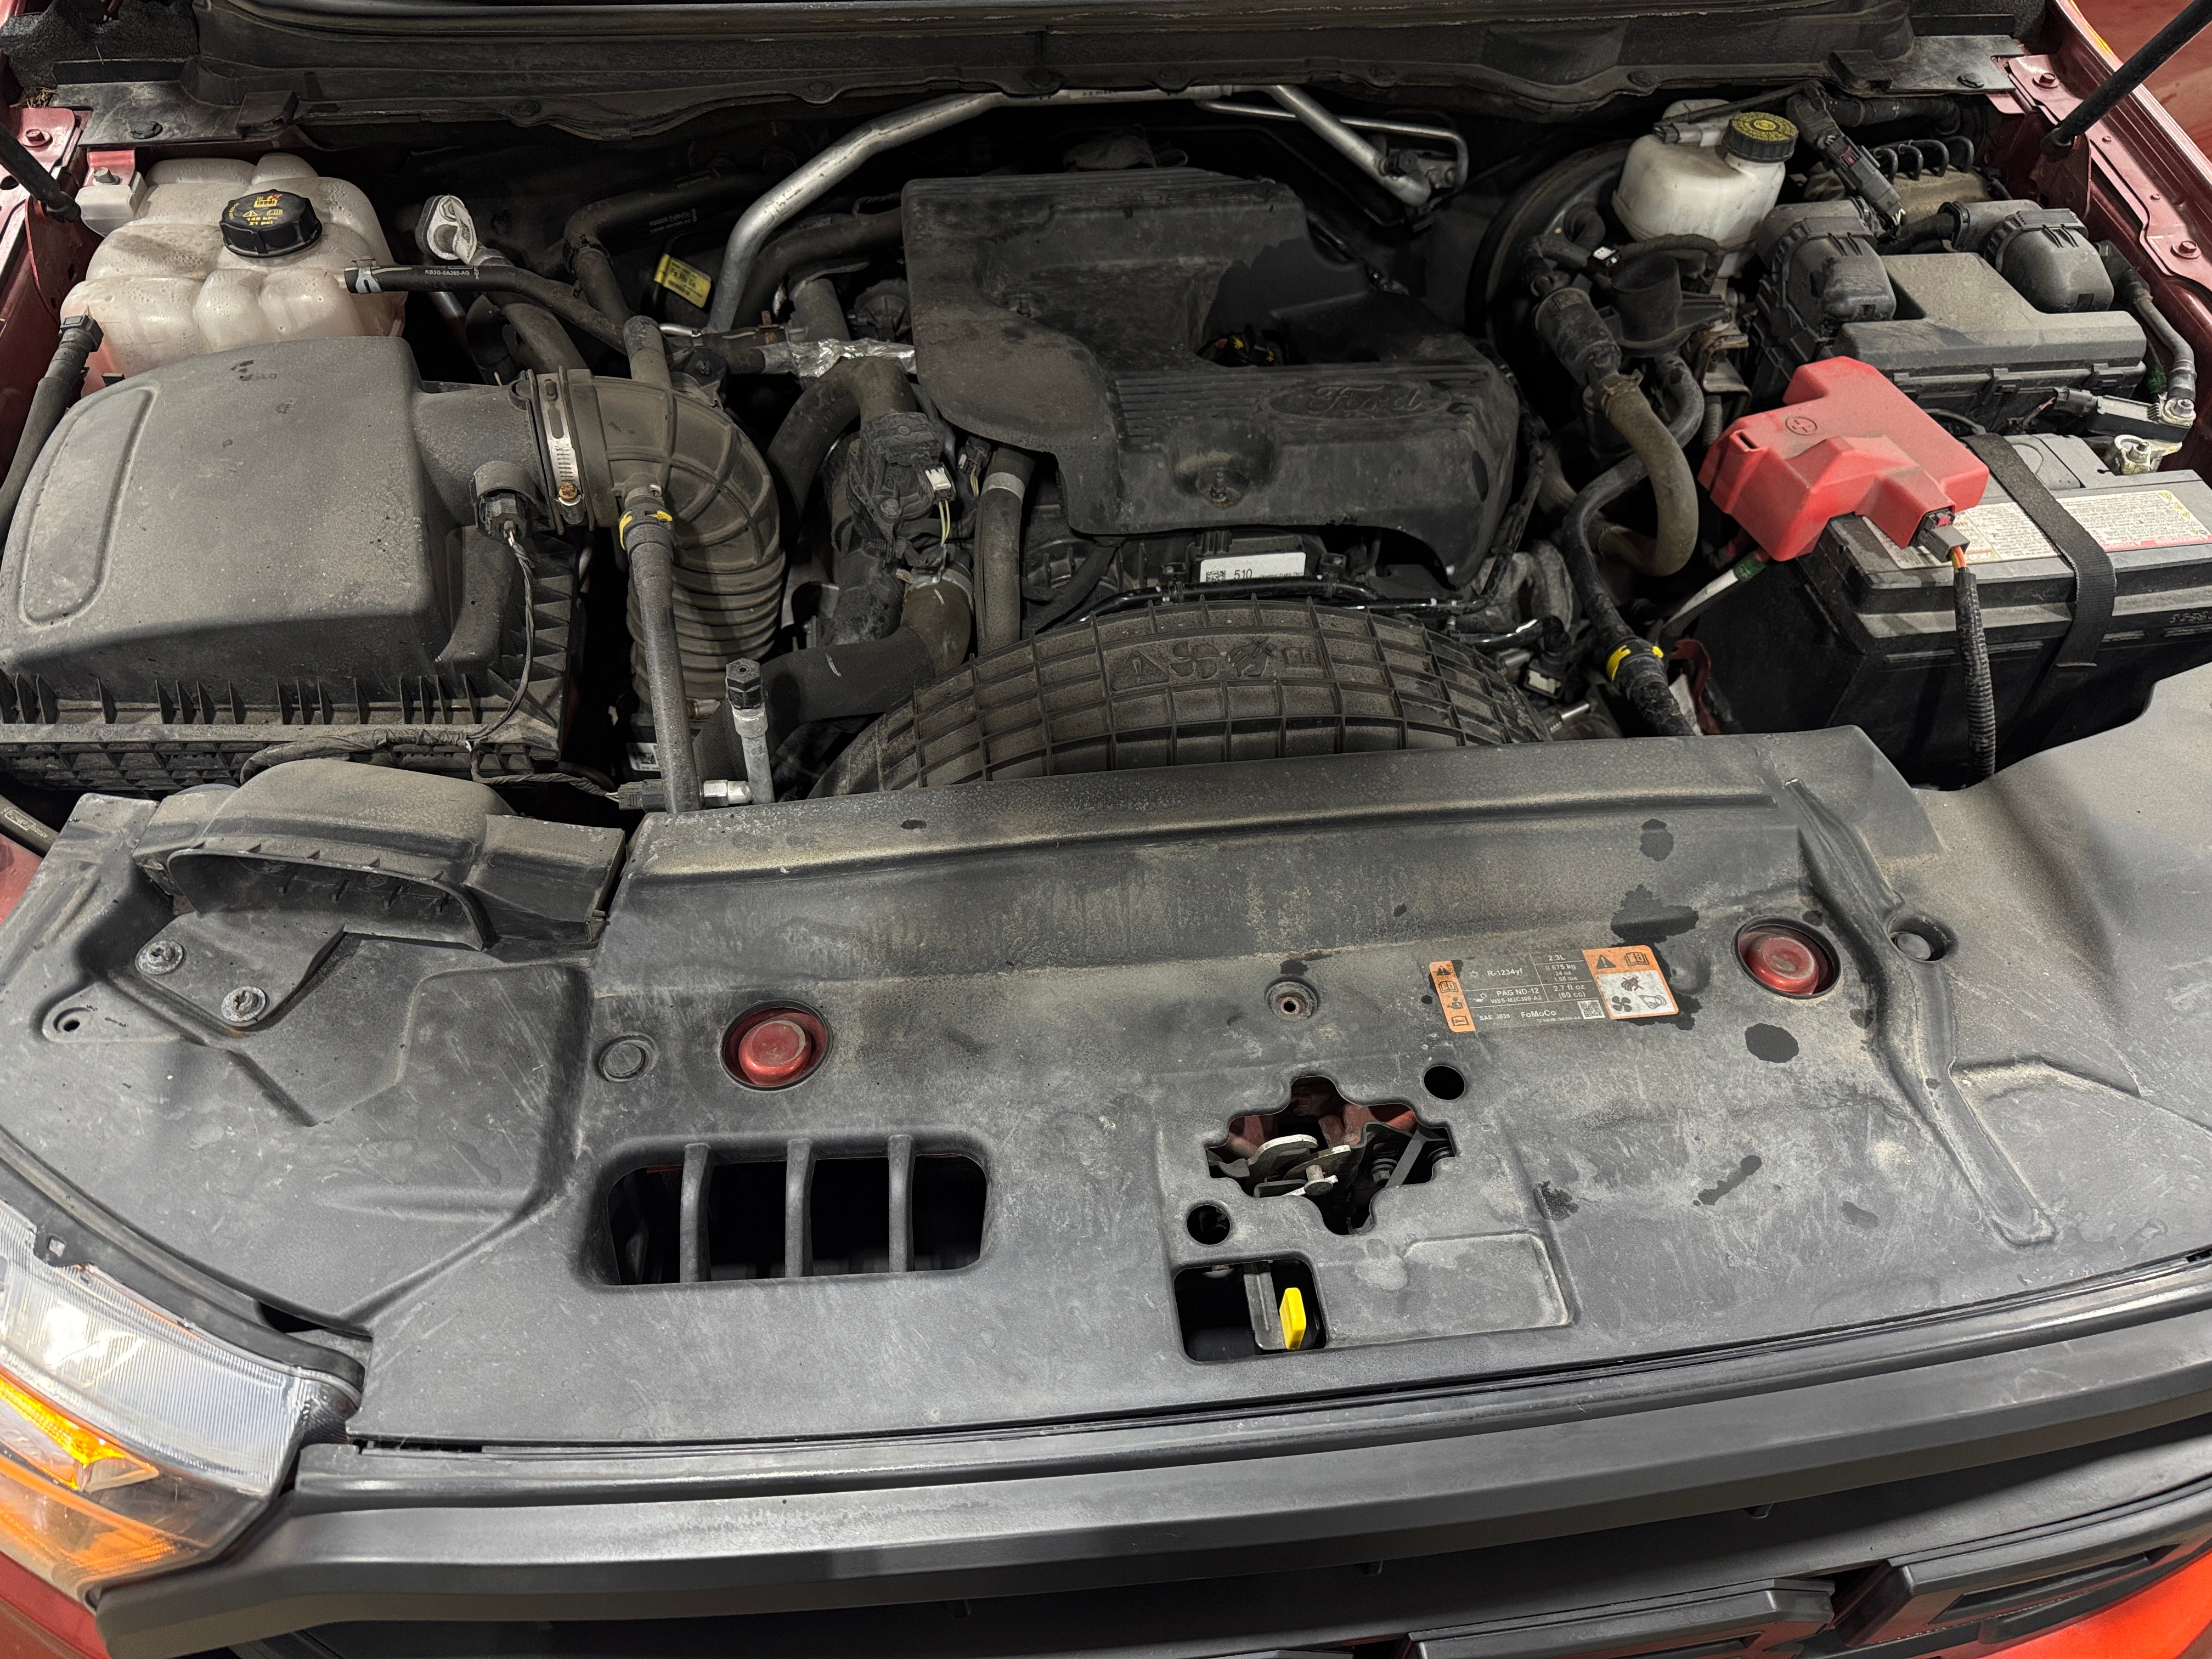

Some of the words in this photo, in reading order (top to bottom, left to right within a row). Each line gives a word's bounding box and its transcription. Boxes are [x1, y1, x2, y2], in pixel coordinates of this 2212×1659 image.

[1234, 568, 1252, 580] 510
[1487, 968, 1523, 977] R-1234yf
[1490, 995, 1542, 1004] WSS-M2C300-A2
[1559, 991, 1571, 1000] (80
[1520, 1009, 1556, 1018] FoMoCo
